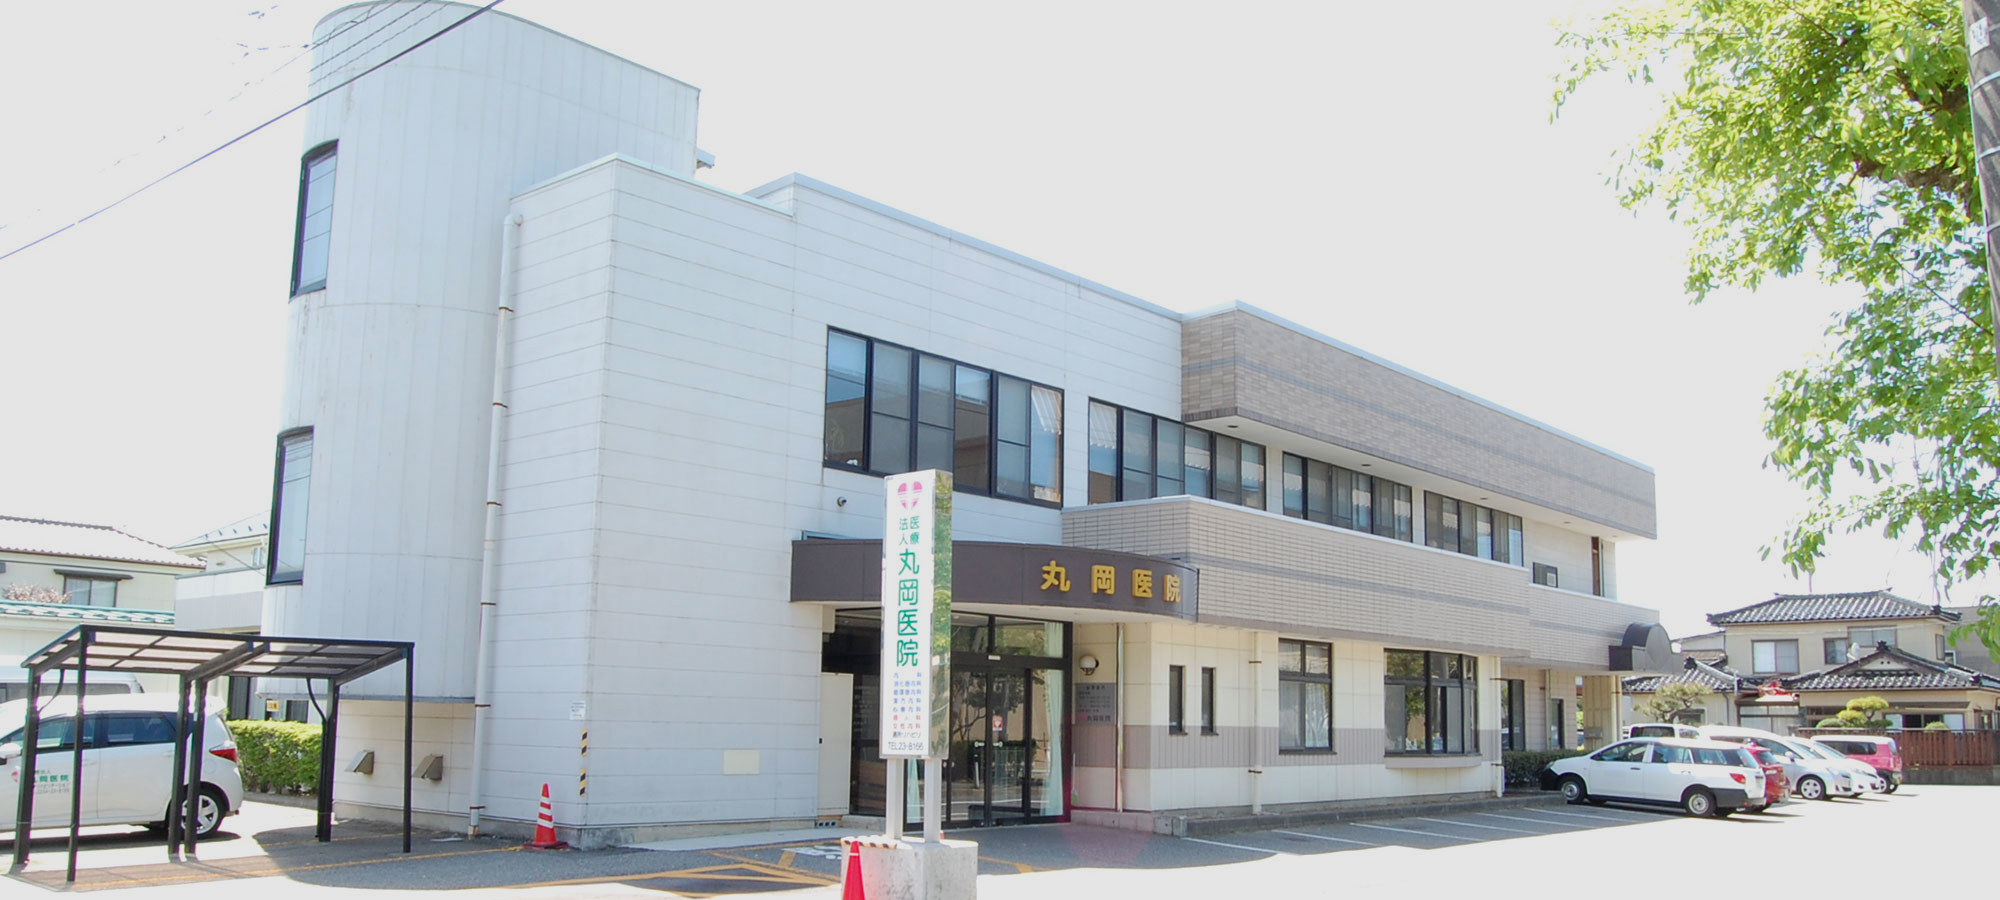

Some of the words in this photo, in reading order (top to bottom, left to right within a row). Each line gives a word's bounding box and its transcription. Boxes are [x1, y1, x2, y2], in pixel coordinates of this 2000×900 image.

[896, 548, 920, 667] 丸岡医院
[1040, 560, 1181, 602] 丸岡医院
